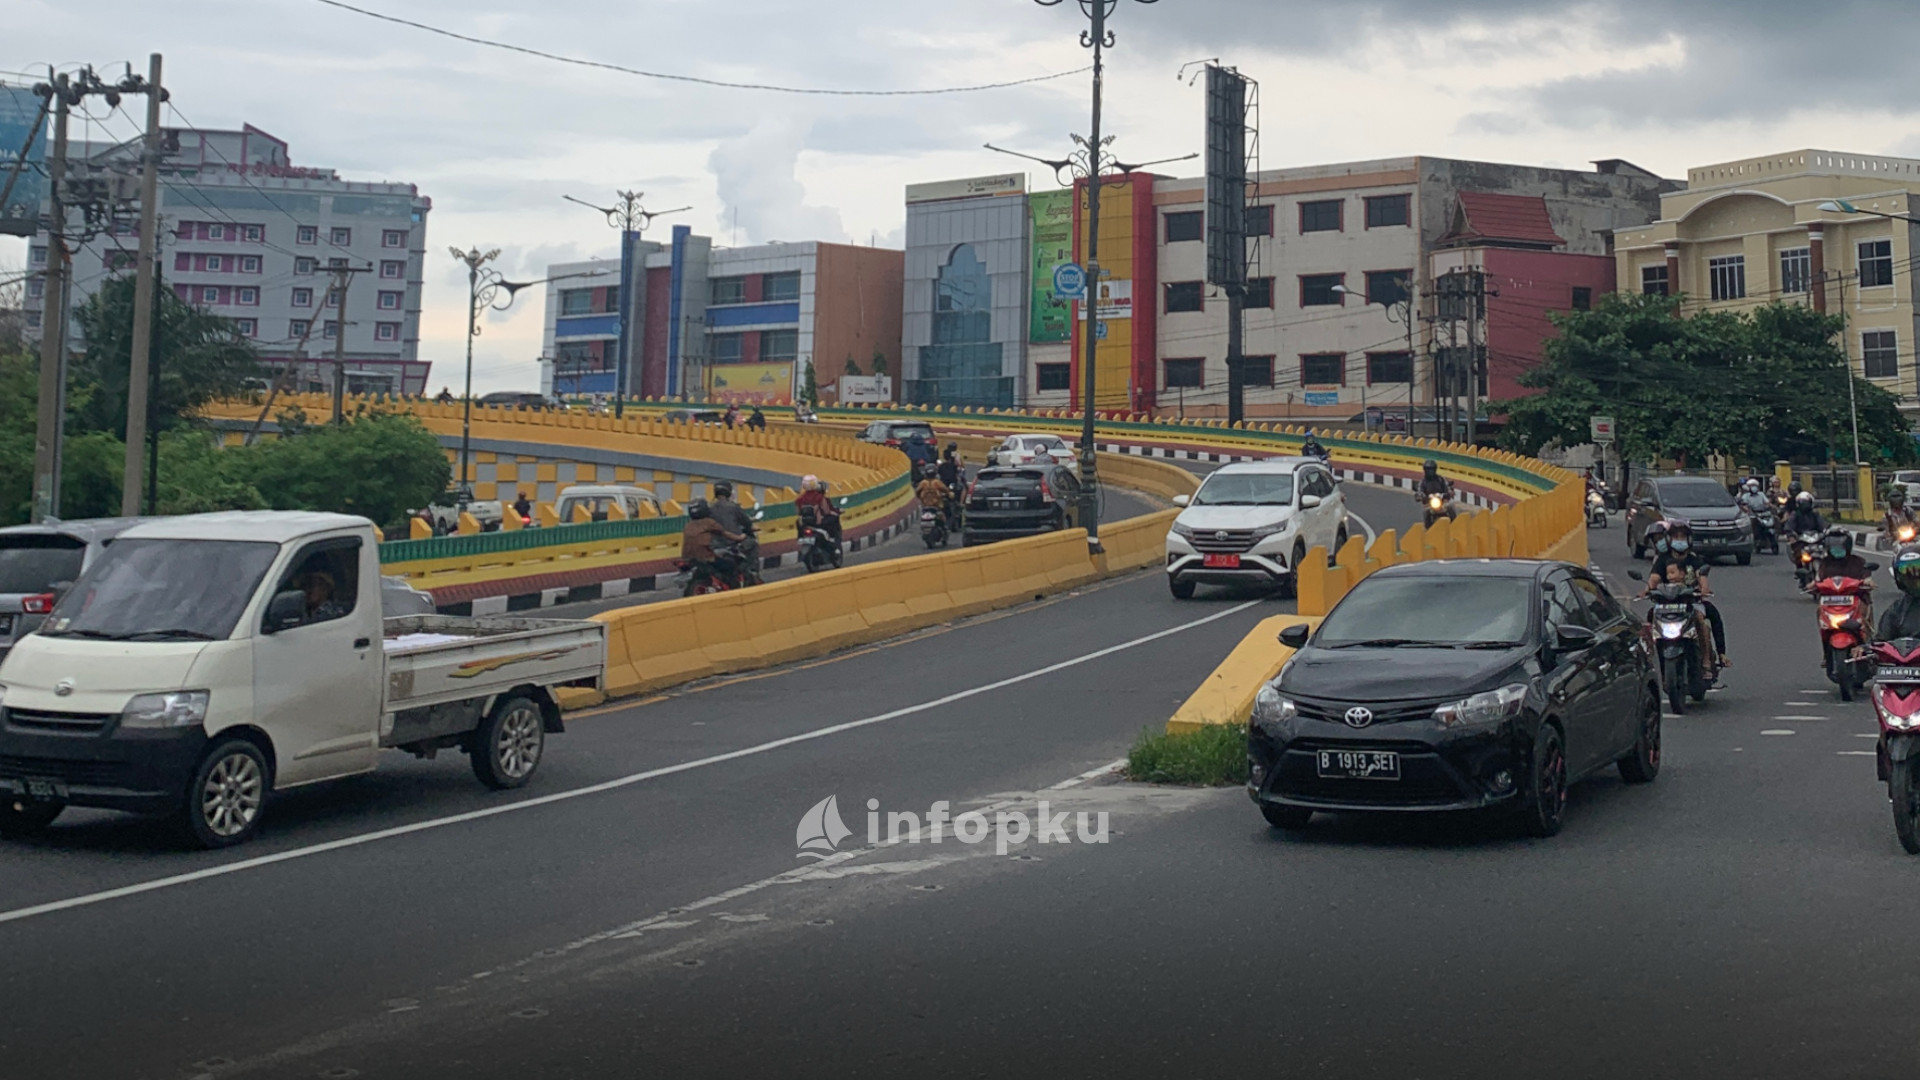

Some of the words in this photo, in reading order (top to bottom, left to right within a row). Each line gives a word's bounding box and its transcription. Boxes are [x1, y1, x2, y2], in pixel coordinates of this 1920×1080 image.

[1060, 273, 1080, 281] STOP
[1321, 752, 1330, 768] B
[1337, 753, 1366, 769] 1913
[1373, 754, 1394, 771] SEI
